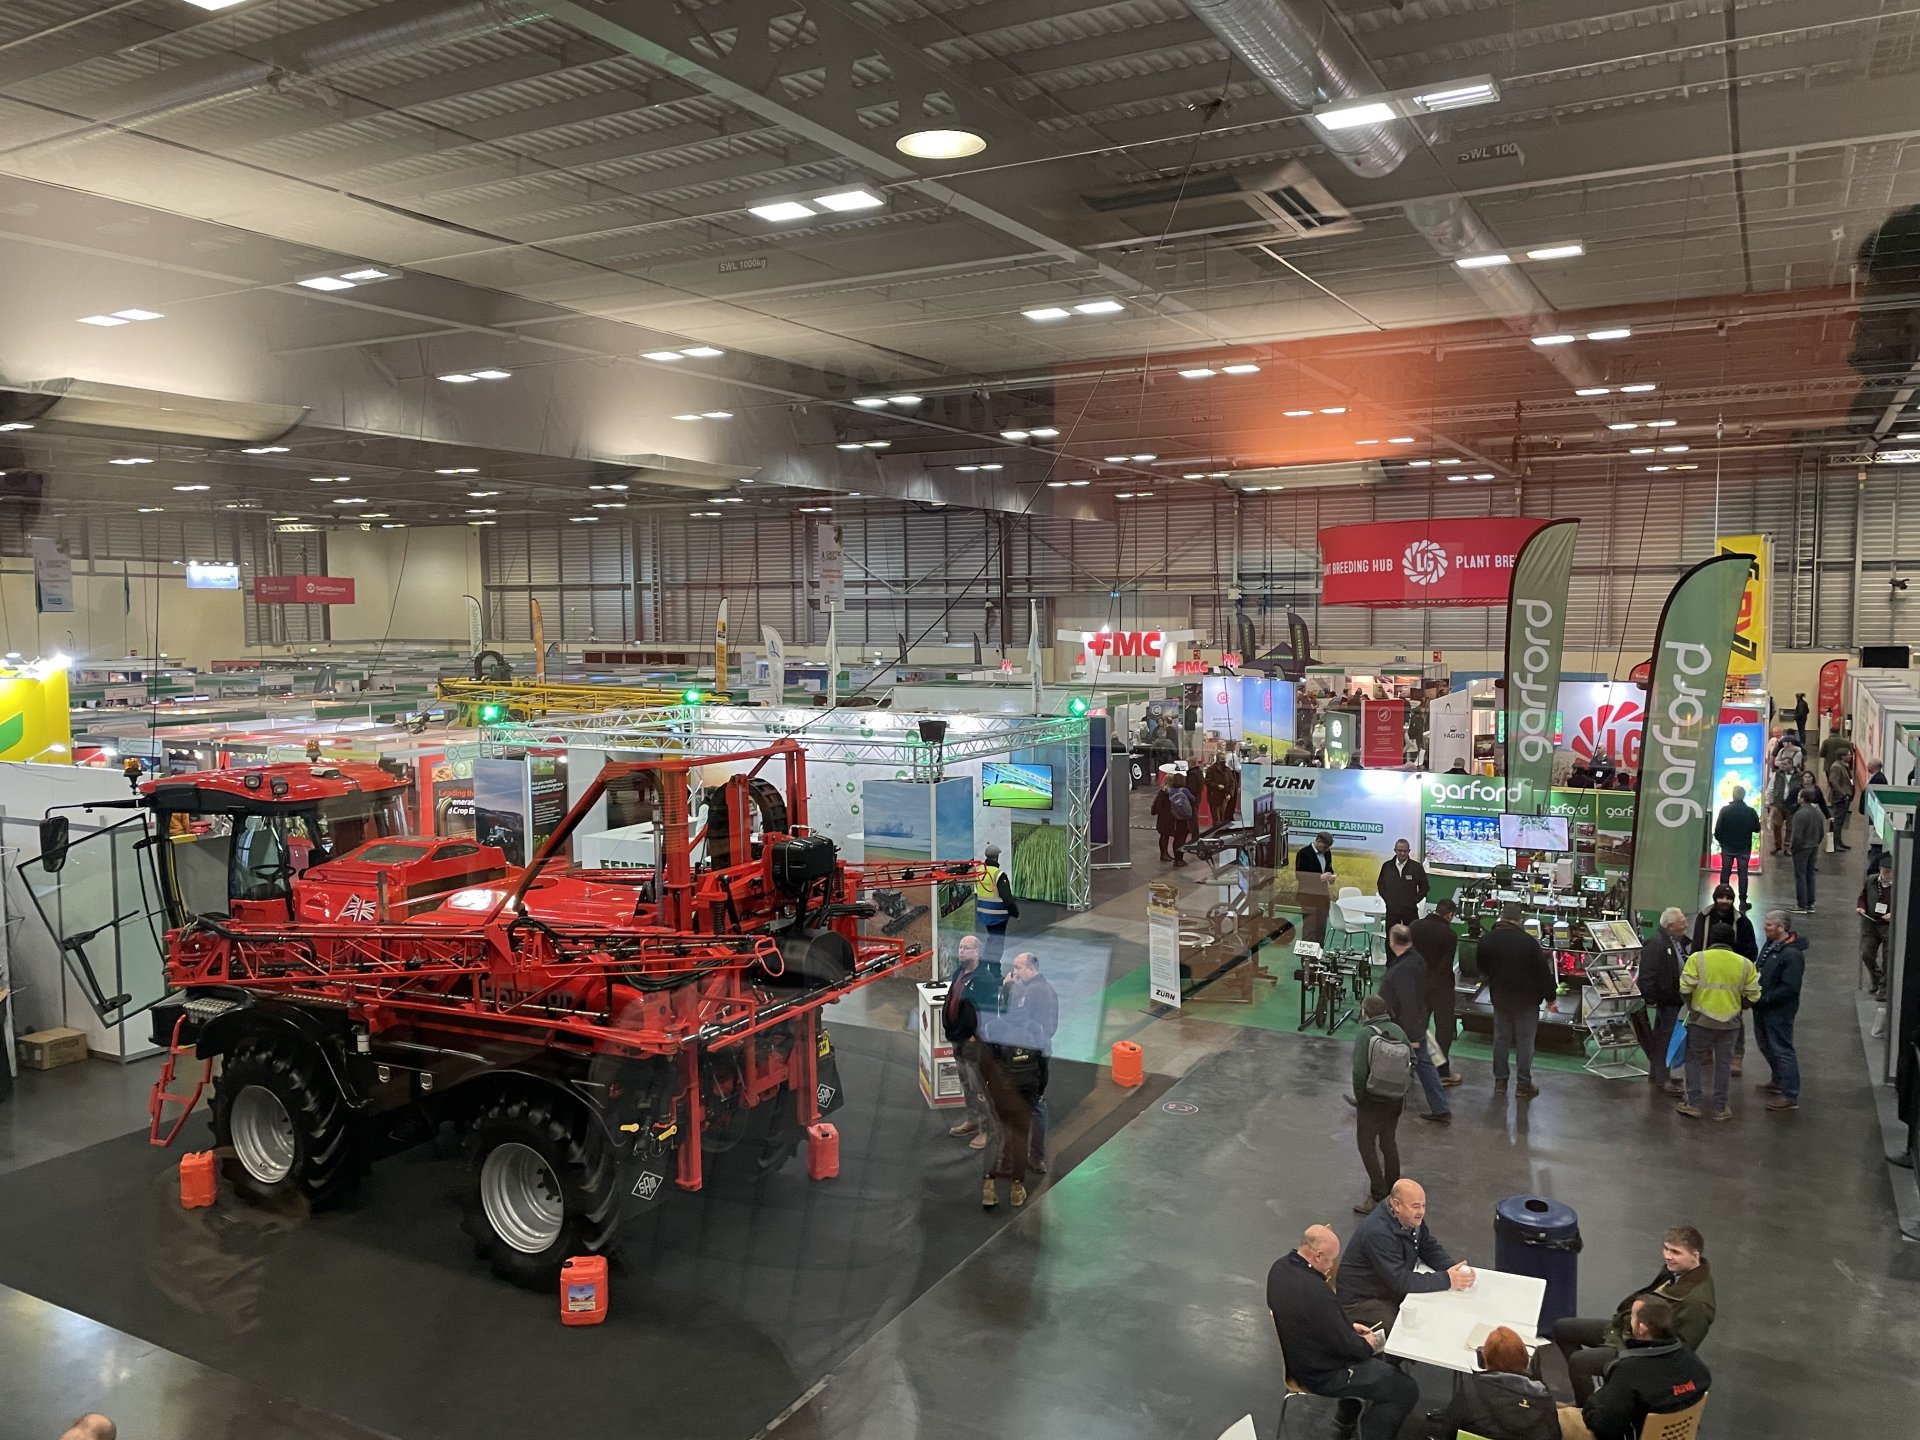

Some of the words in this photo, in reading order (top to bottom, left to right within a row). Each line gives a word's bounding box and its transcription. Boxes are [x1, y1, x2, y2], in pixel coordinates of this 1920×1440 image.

[720, 262, 738, 272] SWL
[739, 258, 767, 270] 1000kg
[1332, 559, 1369, 575] BREEDING
[1372, 558, 1393, 572] HUB
[1416, 552, 1434, 572] LG
[1455, 553, 1491, 569] PLANT
[1087, 631, 1161, 657] FMC
[1172, 660, 1209, 675] FMC
[1513, 598, 1553, 763] garford
[1443, 732, 1466, 740] YAGRO
[1652, 640, 1712, 829] garford
[1262, 776, 1316, 790] ZÜRN
[438, 790, 465, 798] Leading
[1430, 780, 1522, 804] garford
[453, 807, 468, 816] Crop
[1548, 803, 1589, 816] arford
[1339, 822, 1383, 833] FARMING
[1155, 988, 1176, 1001] ZÜRN
[638, 1176, 657, 1195] SAM
